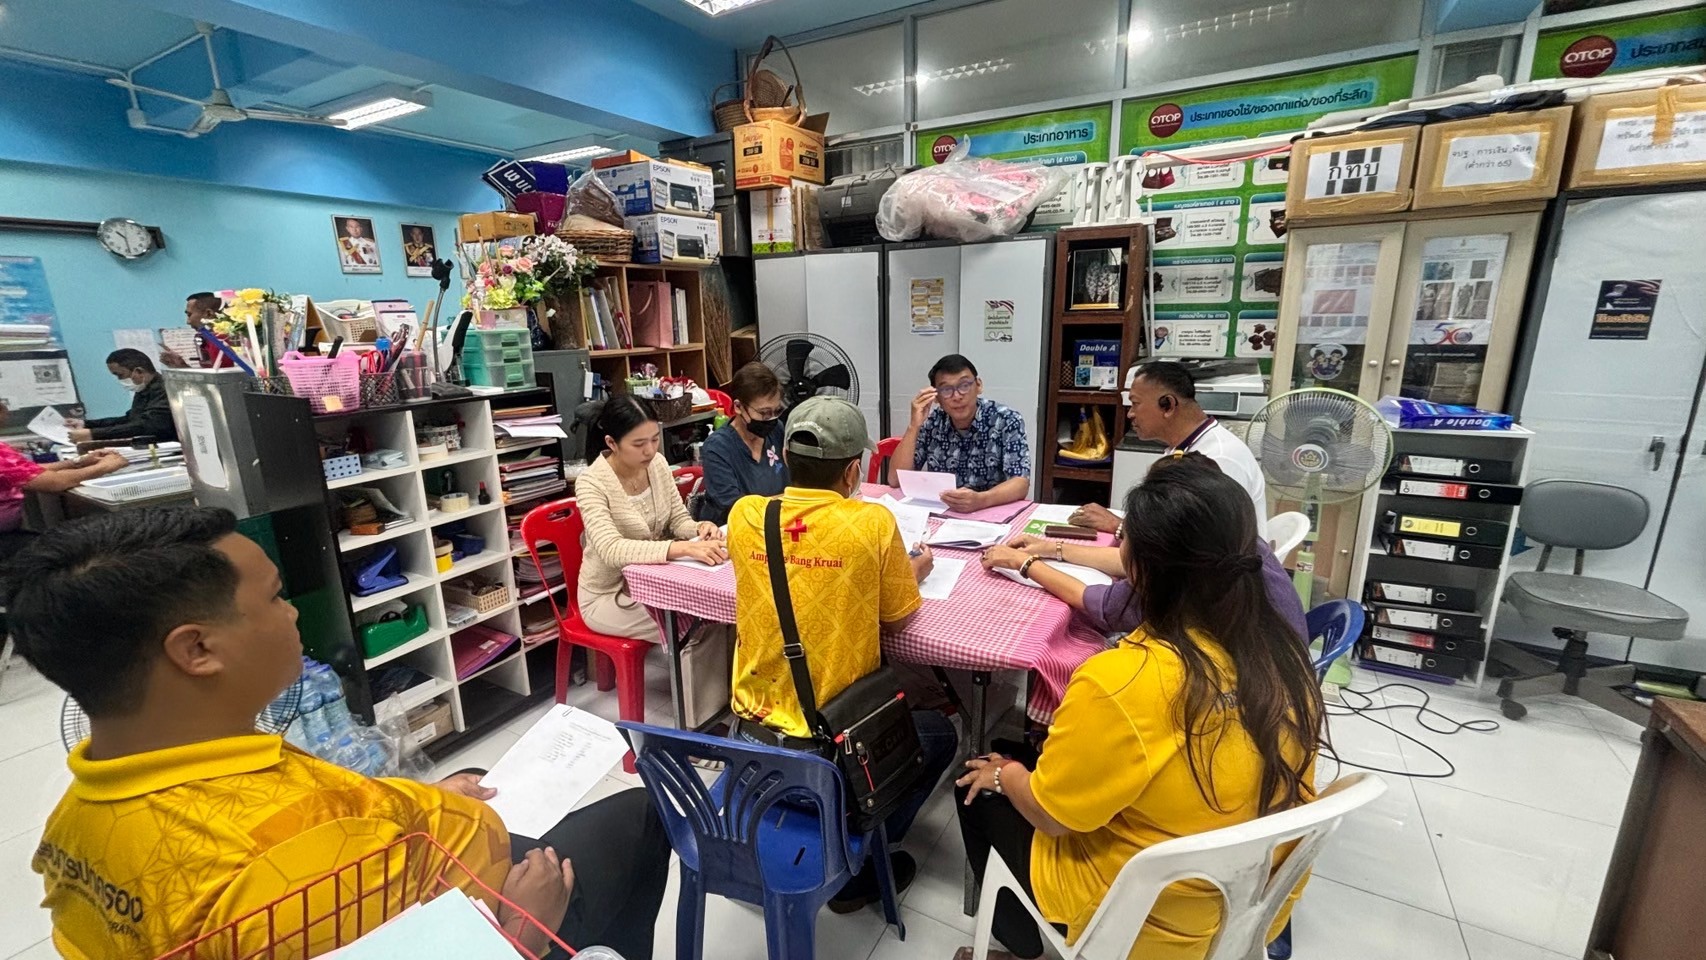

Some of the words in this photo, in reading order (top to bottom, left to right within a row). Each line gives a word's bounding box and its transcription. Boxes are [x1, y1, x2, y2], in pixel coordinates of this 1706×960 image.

[1564, 47, 1613, 63] OTOP
[1190, 88, 1368, 123] ประเภทของใช้/ของตกแต่ง/ของที่ระลึก
[1151, 112, 1181, 125] OTOP
[1023, 127, 1088, 145] ประเภทอาหาร
[1477, 145, 1508, 157] การเงิน
[652, 164, 671, 174] EPSON
[660, 216, 678, 225] EPSON
[1079, 344, 1108, 352] Double
[1109, 344, 1116, 352] A
[1434, 418, 1443, 427] A
[1446, 418, 1492, 427] Double
[749, 550, 788, 565] Ampe
[789, 554, 812, 569] Bang
[814, 556, 843, 568] Kruai
